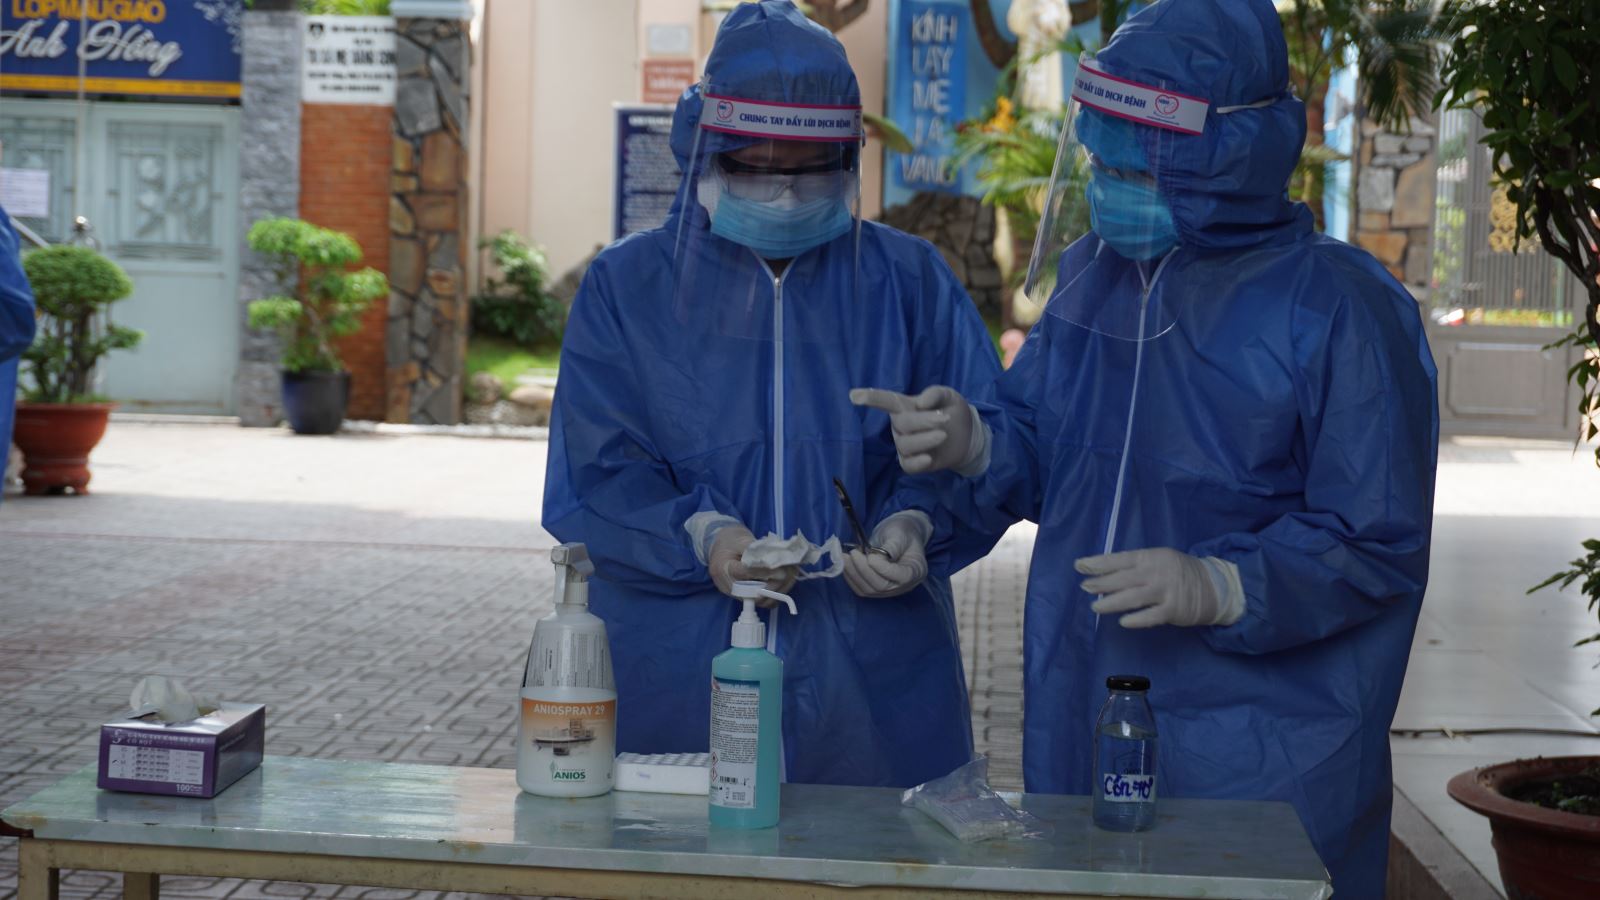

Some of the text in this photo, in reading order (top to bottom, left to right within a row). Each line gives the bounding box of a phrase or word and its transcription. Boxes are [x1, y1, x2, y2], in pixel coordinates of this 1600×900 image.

[739, 113, 768, 124] CHUNG
[770, 116, 784, 125] TAY
[533, 703, 606, 716] ANIOSPRAY 29
[553, 771, 587, 780] ANIOS
